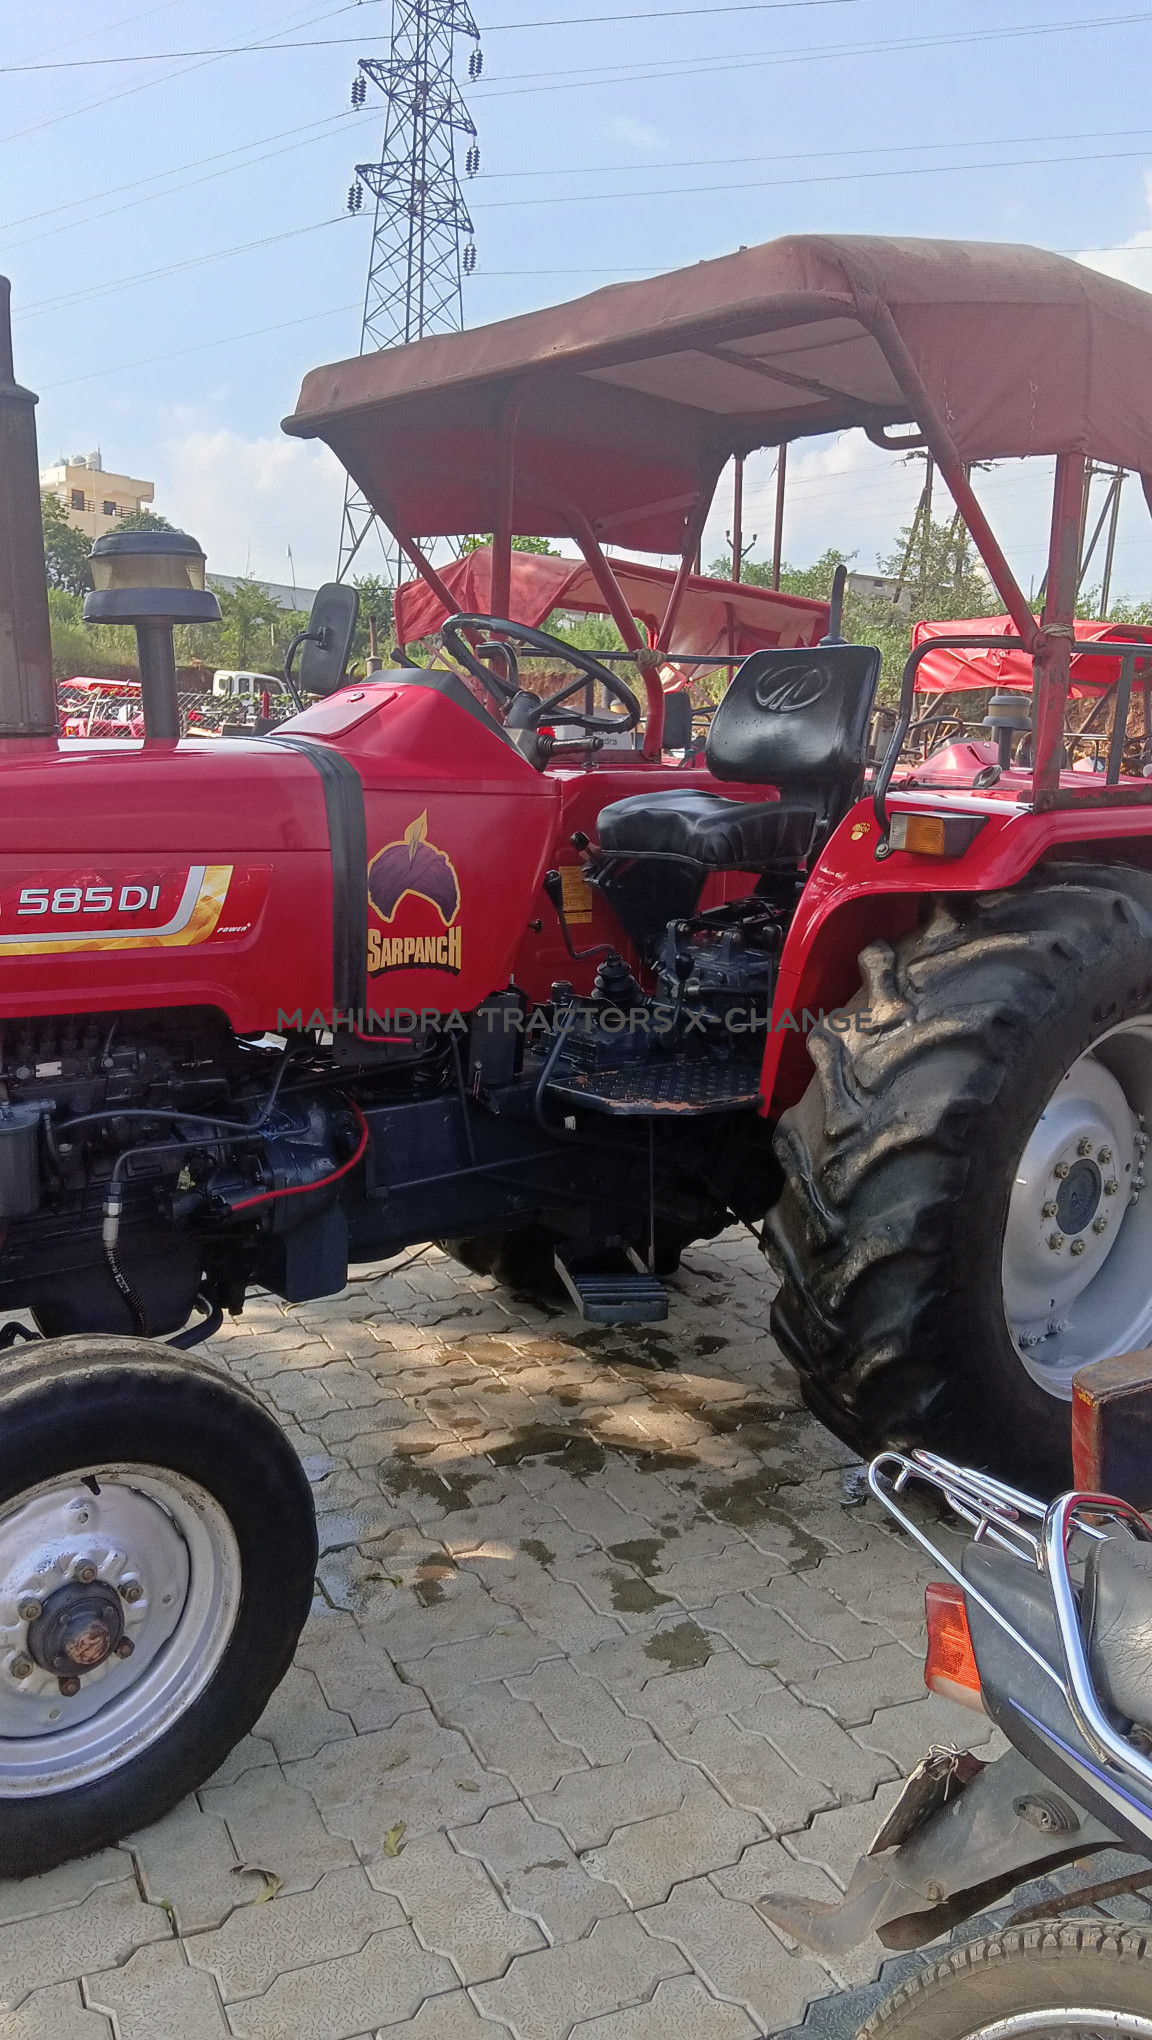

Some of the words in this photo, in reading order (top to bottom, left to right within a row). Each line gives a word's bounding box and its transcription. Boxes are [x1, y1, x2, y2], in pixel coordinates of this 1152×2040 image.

[17, 887, 114, 915] 585
[117, 885, 160, 911] DI
[367, 926, 462, 973] SARPANCH
